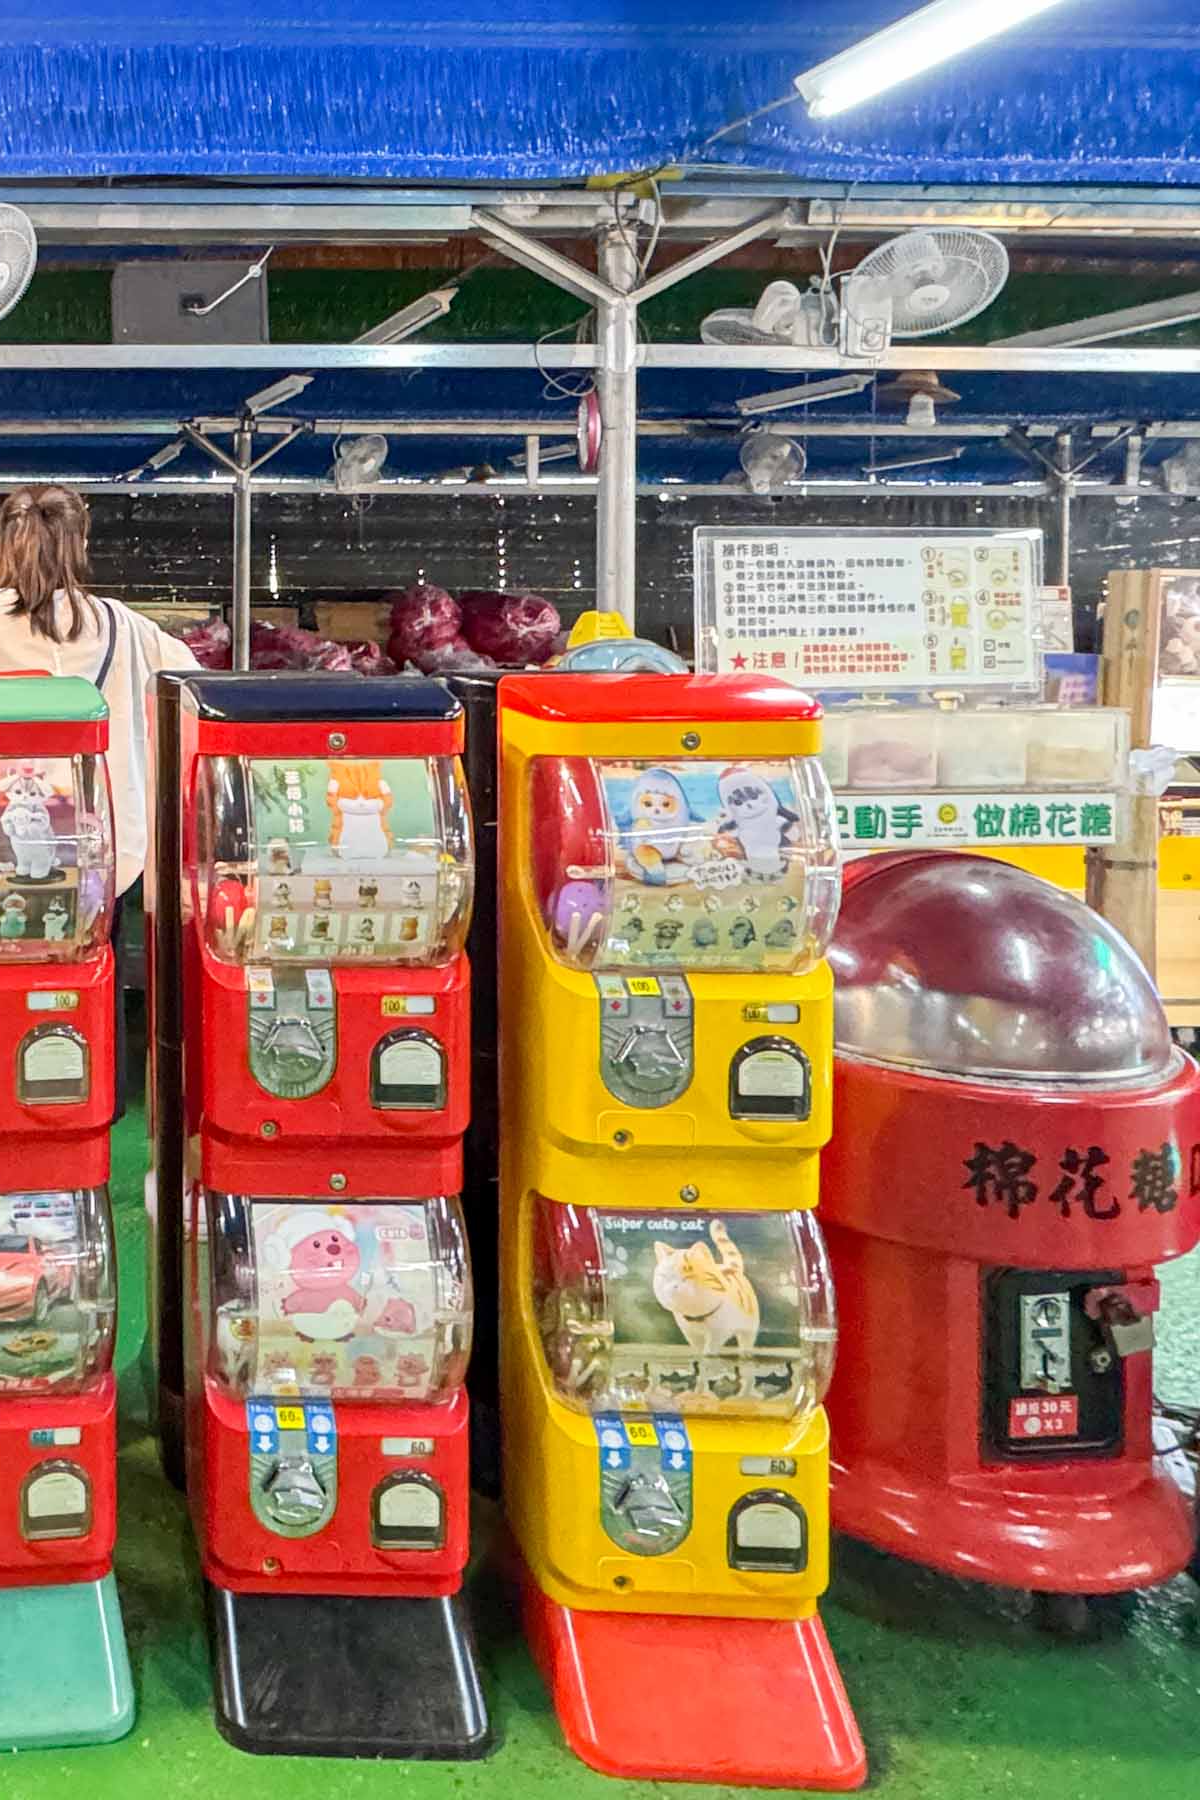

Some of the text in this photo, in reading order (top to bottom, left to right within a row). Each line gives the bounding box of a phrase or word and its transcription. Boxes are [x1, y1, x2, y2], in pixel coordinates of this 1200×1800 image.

[973, 803, 1113, 838] 做棉花糖
[961, 1141, 1200, 1220] 棉花糖
[604, 1216, 706, 1233] Super cute cat
